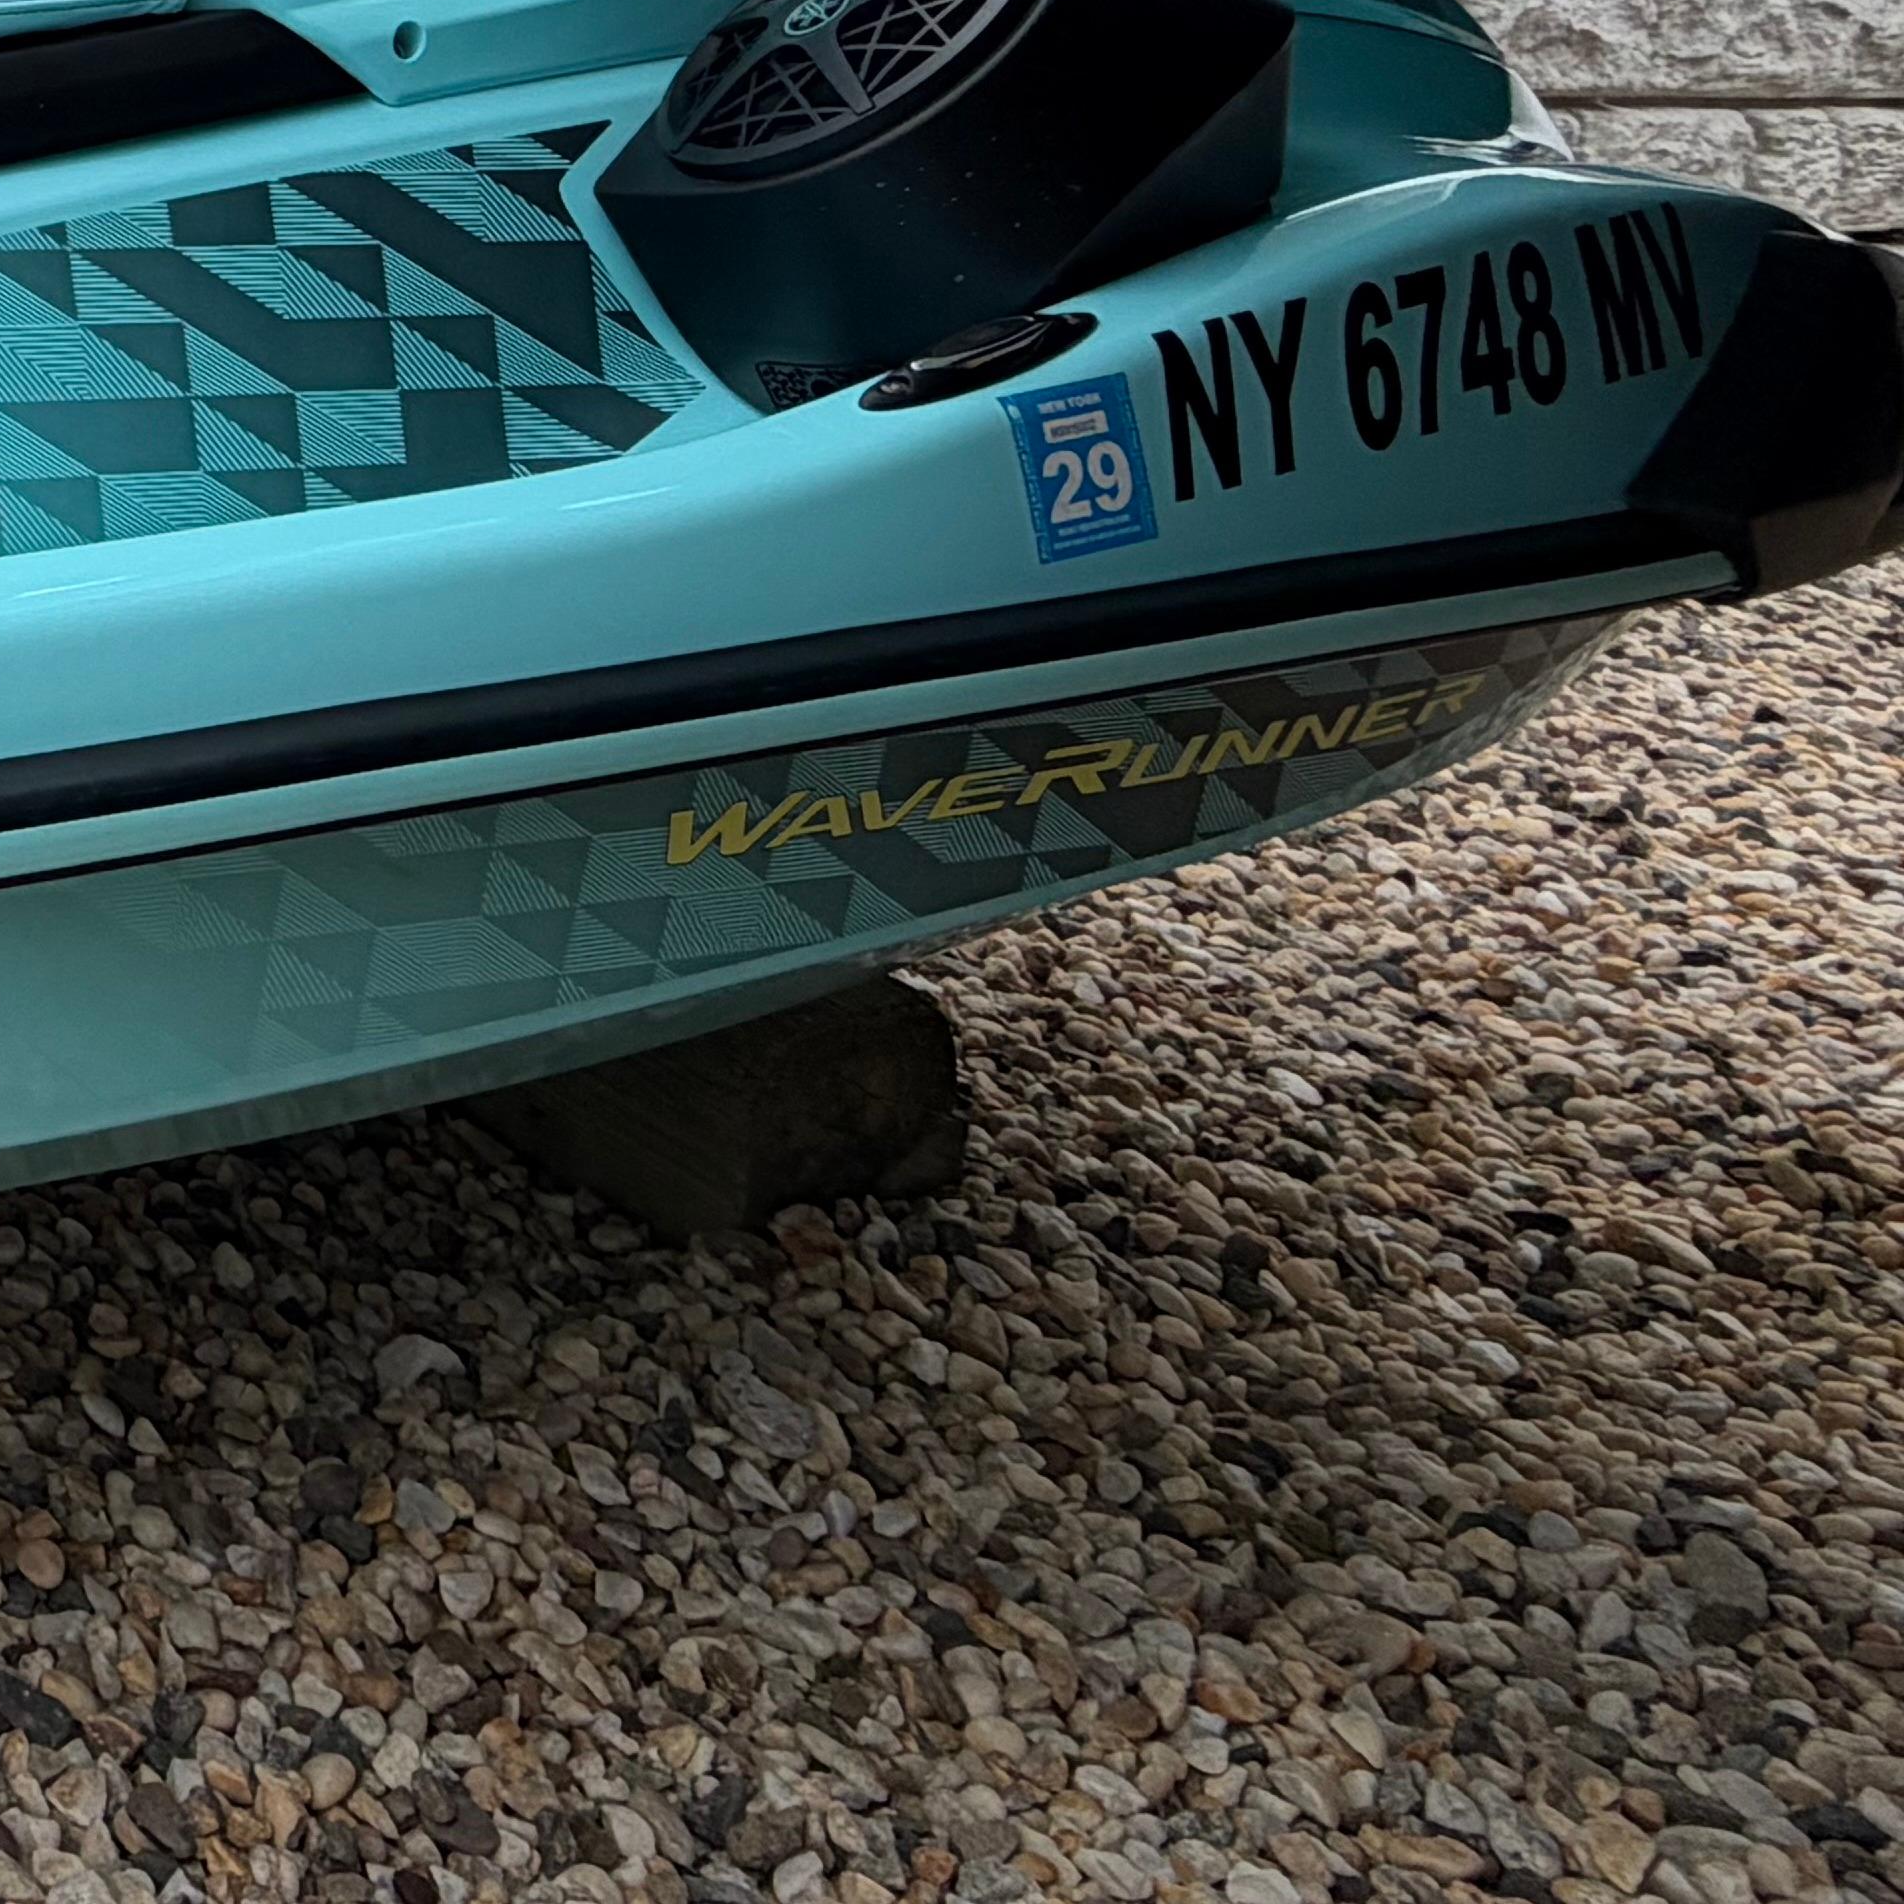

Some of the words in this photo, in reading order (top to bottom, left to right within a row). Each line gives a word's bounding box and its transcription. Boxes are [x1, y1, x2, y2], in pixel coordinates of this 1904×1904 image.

[1152, 297, 1307, 503] NY
[1343, 241, 1567, 452] 6748
[1576, 202, 1704, 386] MV
[1042, 440, 1134, 524] 29
[665, 672, 1485, 867] WAVERUNNER
